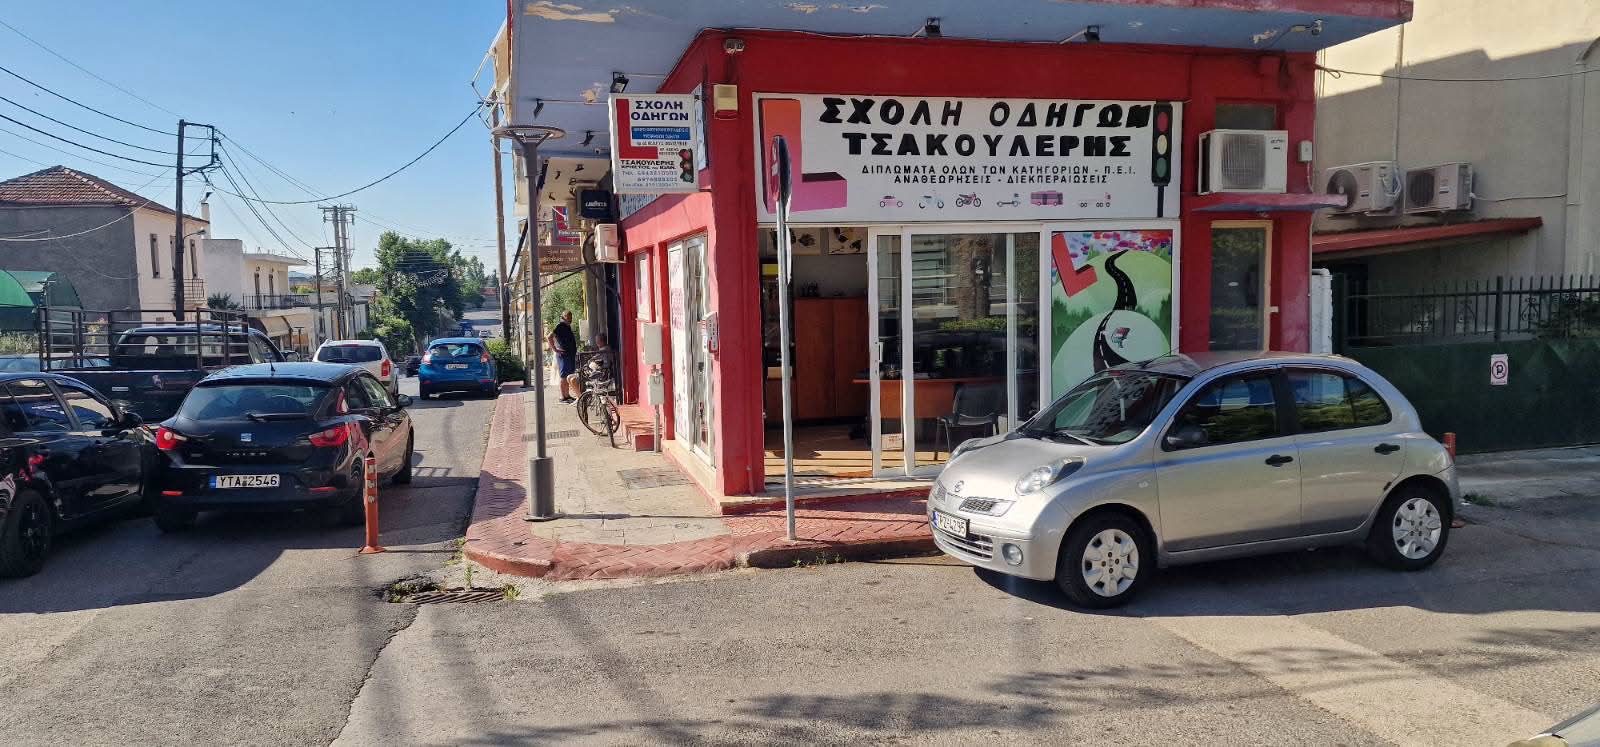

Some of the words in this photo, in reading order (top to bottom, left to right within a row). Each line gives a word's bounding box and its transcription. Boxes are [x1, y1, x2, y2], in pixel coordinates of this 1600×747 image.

[635, 101, 683, 109] ΣΧΟΛΗ
[631, 112, 689, 120] ΟΔΗΓΩΝ
[819, 97, 963, 126] ΣΧΟΛΗ
[989, 102, 1152, 129] ΟΔΗΓΩΝ
[842, 132, 1132, 157] ΤΣΑΚΟΥΛΕΡΗΣ
[861, 165, 936, 175] ΔΙΠΛΩΜΑΤΑ
[942, 165, 976, 175] ΟΛΩΝ
[982, 165, 1006, 175] ΤΩΝ
[1012, 165, 1089, 175] ΚΑΤΗΓΟΡΙΩΝ
[1104, 166, 1136, 175] Π.Ε.Ι.
[894, 175, 992, 184] ΑΝΑΘΕΩΡΗΣΕΙΣ
[1007, 175, 1108, 184] ΔΙΕΚΠΕΡΑΙΩΣΕΙΣ
